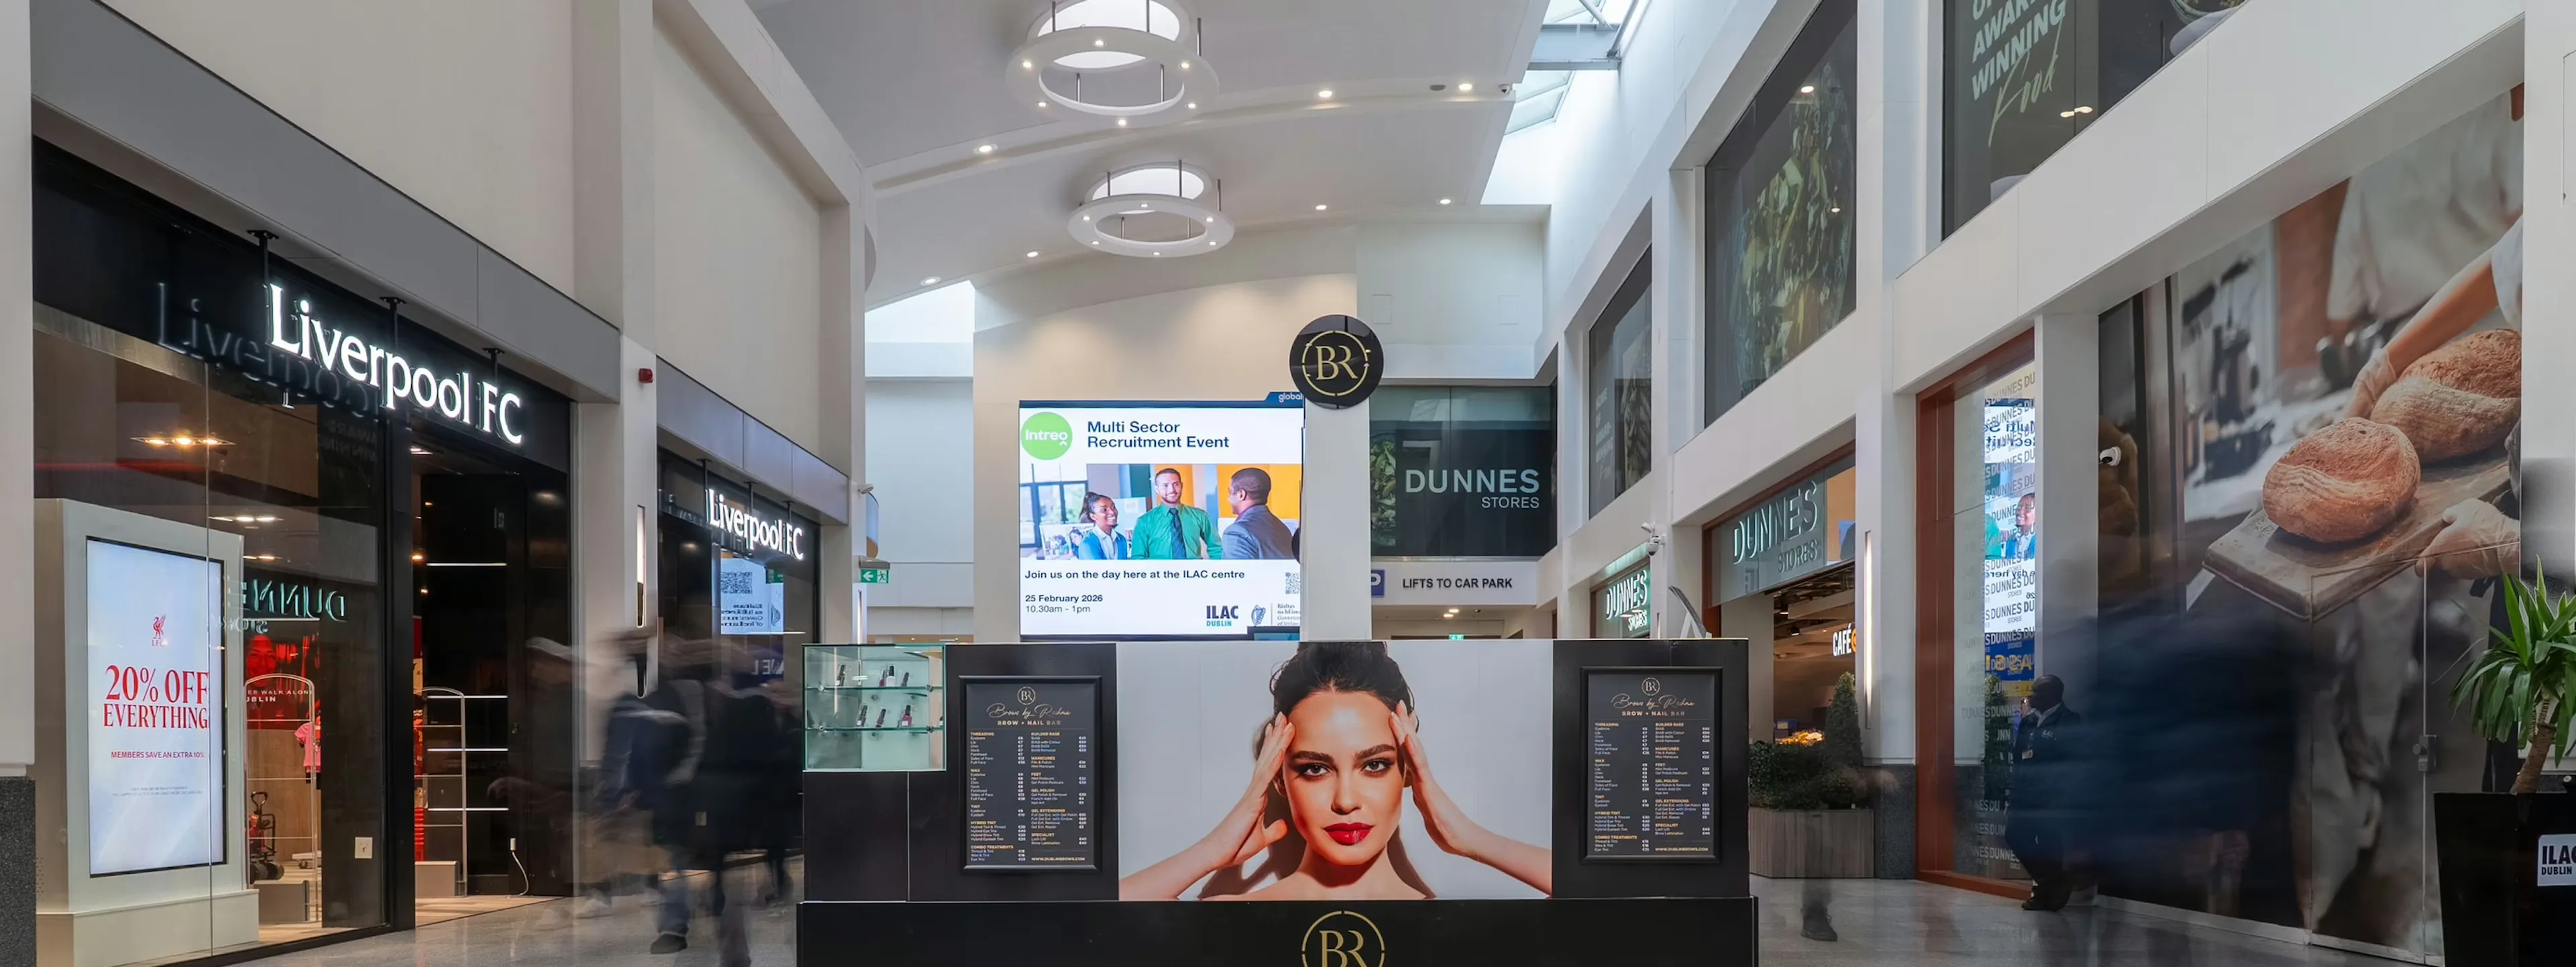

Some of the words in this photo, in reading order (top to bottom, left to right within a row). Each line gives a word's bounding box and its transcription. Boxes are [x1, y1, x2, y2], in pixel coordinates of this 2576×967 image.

[1988, 27, 2061, 148] Food
[270, 283, 470, 424] Liverpool
[480, 380, 523, 444] FC
[1315, 345, 1358, 380] BR
[1278, 393, 1302, 402] global
[1087, 421, 1125, 433] Multi
[1129, 421, 1180, 433] Sector
[1025, 429, 1068, 442] Intreo
[1087, 436, 1182, 448] Recruitment
[1186, 436, 1229, 448] Event
[1405, 469, 1540, 494] DUNNES
[1481, 497, 1540, 508] STORES
[706, 489, 783, 552] Liverpool
[787, 523, 804, 560] FC
[1733, 480, 1818, 565] DUNNES
[1778, 540, 1818, 574] STORES
[1025, 570, 1047, 579] Join
[1081, 570, 1099, 579] the
[1101, 570, 1120, 580] day
[1123, 570, 1146, 579] here
[1149, 570, 1161, 579] at
[1163, 570, 1180, 579] the
[1183, 570, 1208, 579] ILAC
[1211, 570, 1245, 579] centre
[1403, 578, 1434, 589] LIFTS
[1436, 578, 1452, 589] TO
[1455, 578, 1479, 589] CAR
[1482, 578, 1513, 589] PARK
[1990, 576, 2022, 595] DUNNES
[1025, 595, 1036, 603] 25
[1038, 595, 1079, 605] February
[1081, 595, 1104, 603] 2026
[1606, 569, 1648, 620] DUNNES
[1025, 605, 1063, 613] 10.30am
[1072, 605, 1091, 615] 1pm
[1205, 605, 1238, 619] ILAC
[1990, 602, 2022, 620] DUNNES
[1833, 622, 1852, 657] CAFÉ
[1990, 629, 2023, 646] DUNNES
[105, 664, 159, 703] 20%
[164, 670, 209, 704] OFF
[1645, 680, 1657, 692] BR
[1020, 690, 1033, 701] BR
[1646, 698, 1660, 710] by
[103, 703, 209, 729] EVERYTHING
[1022, 707, 1035, 719] by
[111, 751, 145, 759] MEMBERS
[145, 751, 162, 759] SAVE
[163, 751, 172, 759] AN
[172, 751, 193, 759] EXTRA
[2541, 866, 2572, 875] DUBLIN
[1318, 930, 1368, 967] BR
